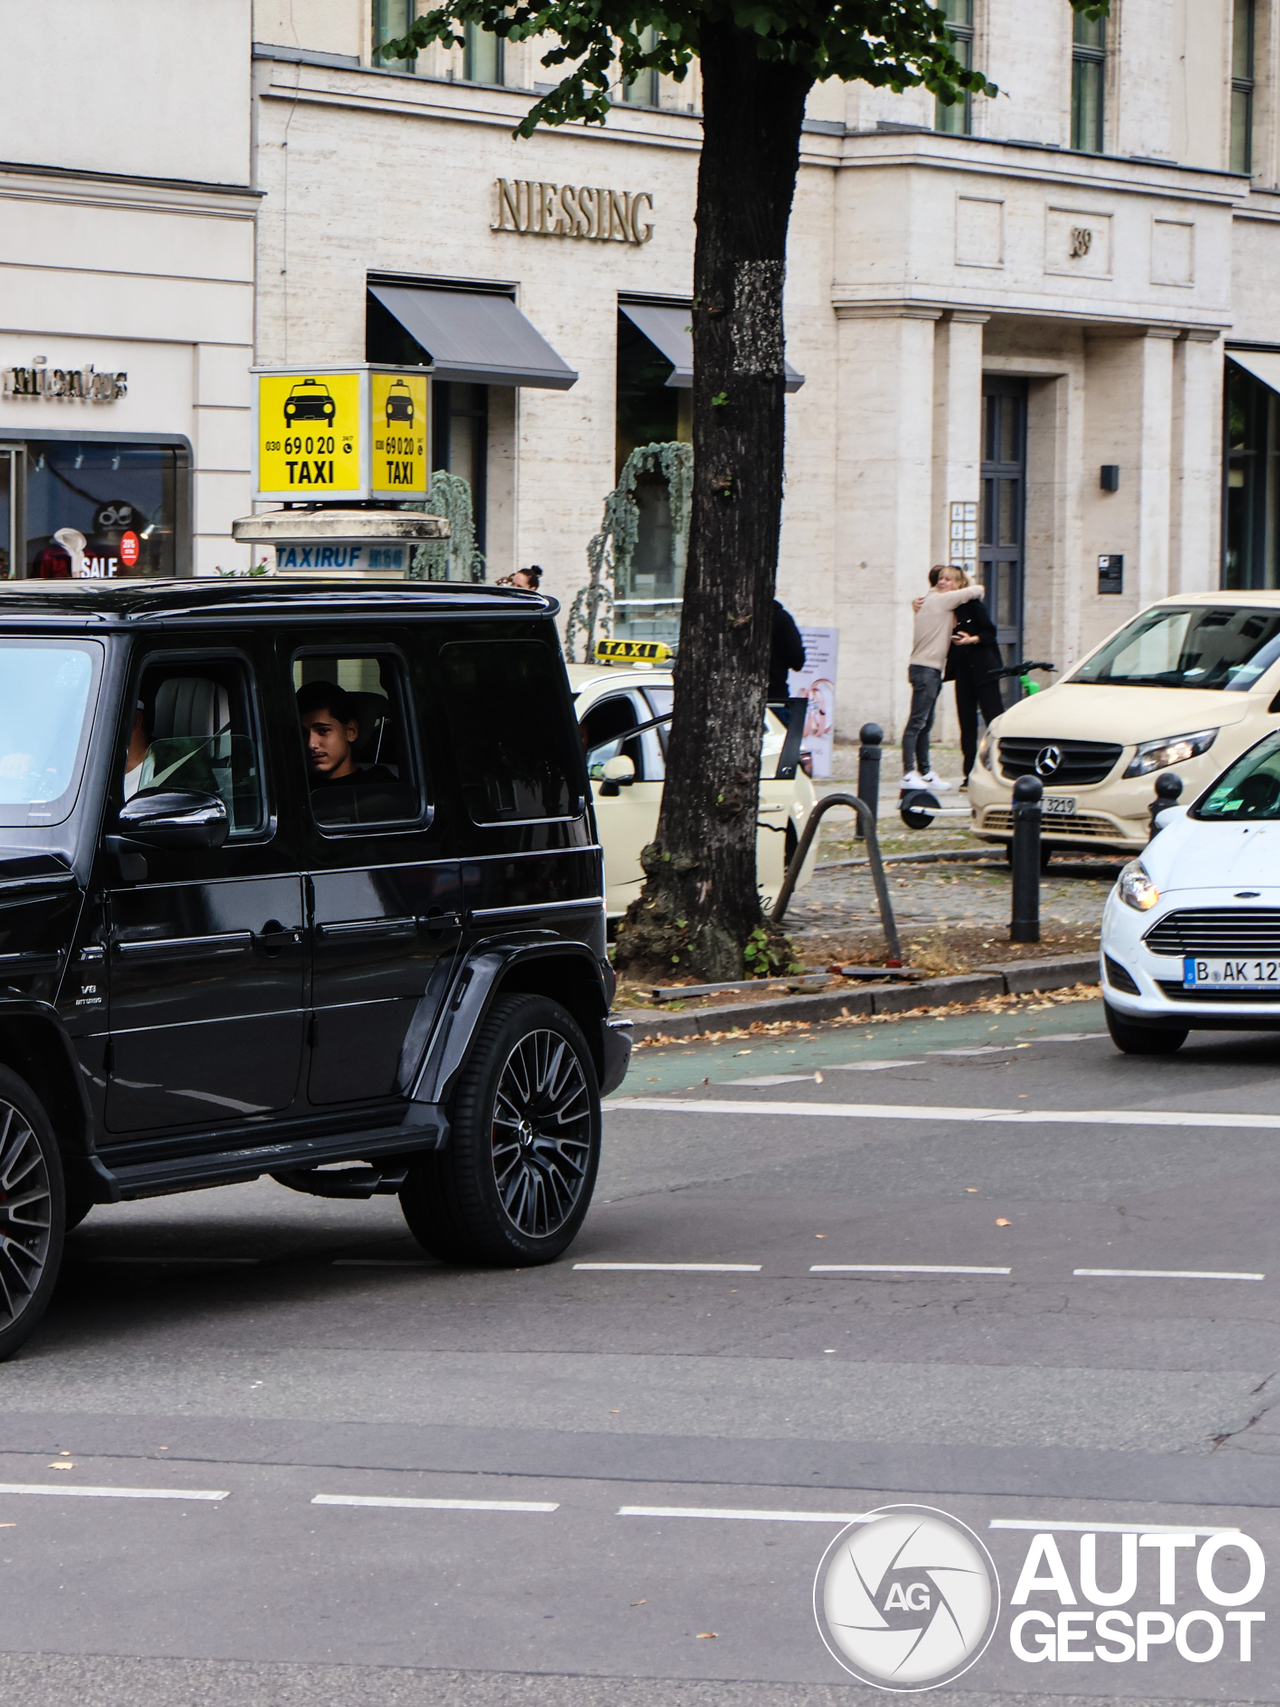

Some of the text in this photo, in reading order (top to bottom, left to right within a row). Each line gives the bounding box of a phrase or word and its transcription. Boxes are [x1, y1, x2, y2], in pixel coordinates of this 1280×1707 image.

[490, 177, 656, 244] NIESSING
[4, 355, 128, 400] mientus
[265, 441, 281, 451] 030
[285, 461, 334, 484] TAXI
[386, 461, 413, 485] TAXI
[81, 557, 118, 578] SALE
[276, 546, 362, 568] TAXIRUF
[605, 642, 651, 657] TAXI
[1046, 799, 1074, 813] 3219
[1196, 961, 1209, 981] B
[1223, 961, 1248, 981] AK
[1253, 961, 1280, 981] 12
